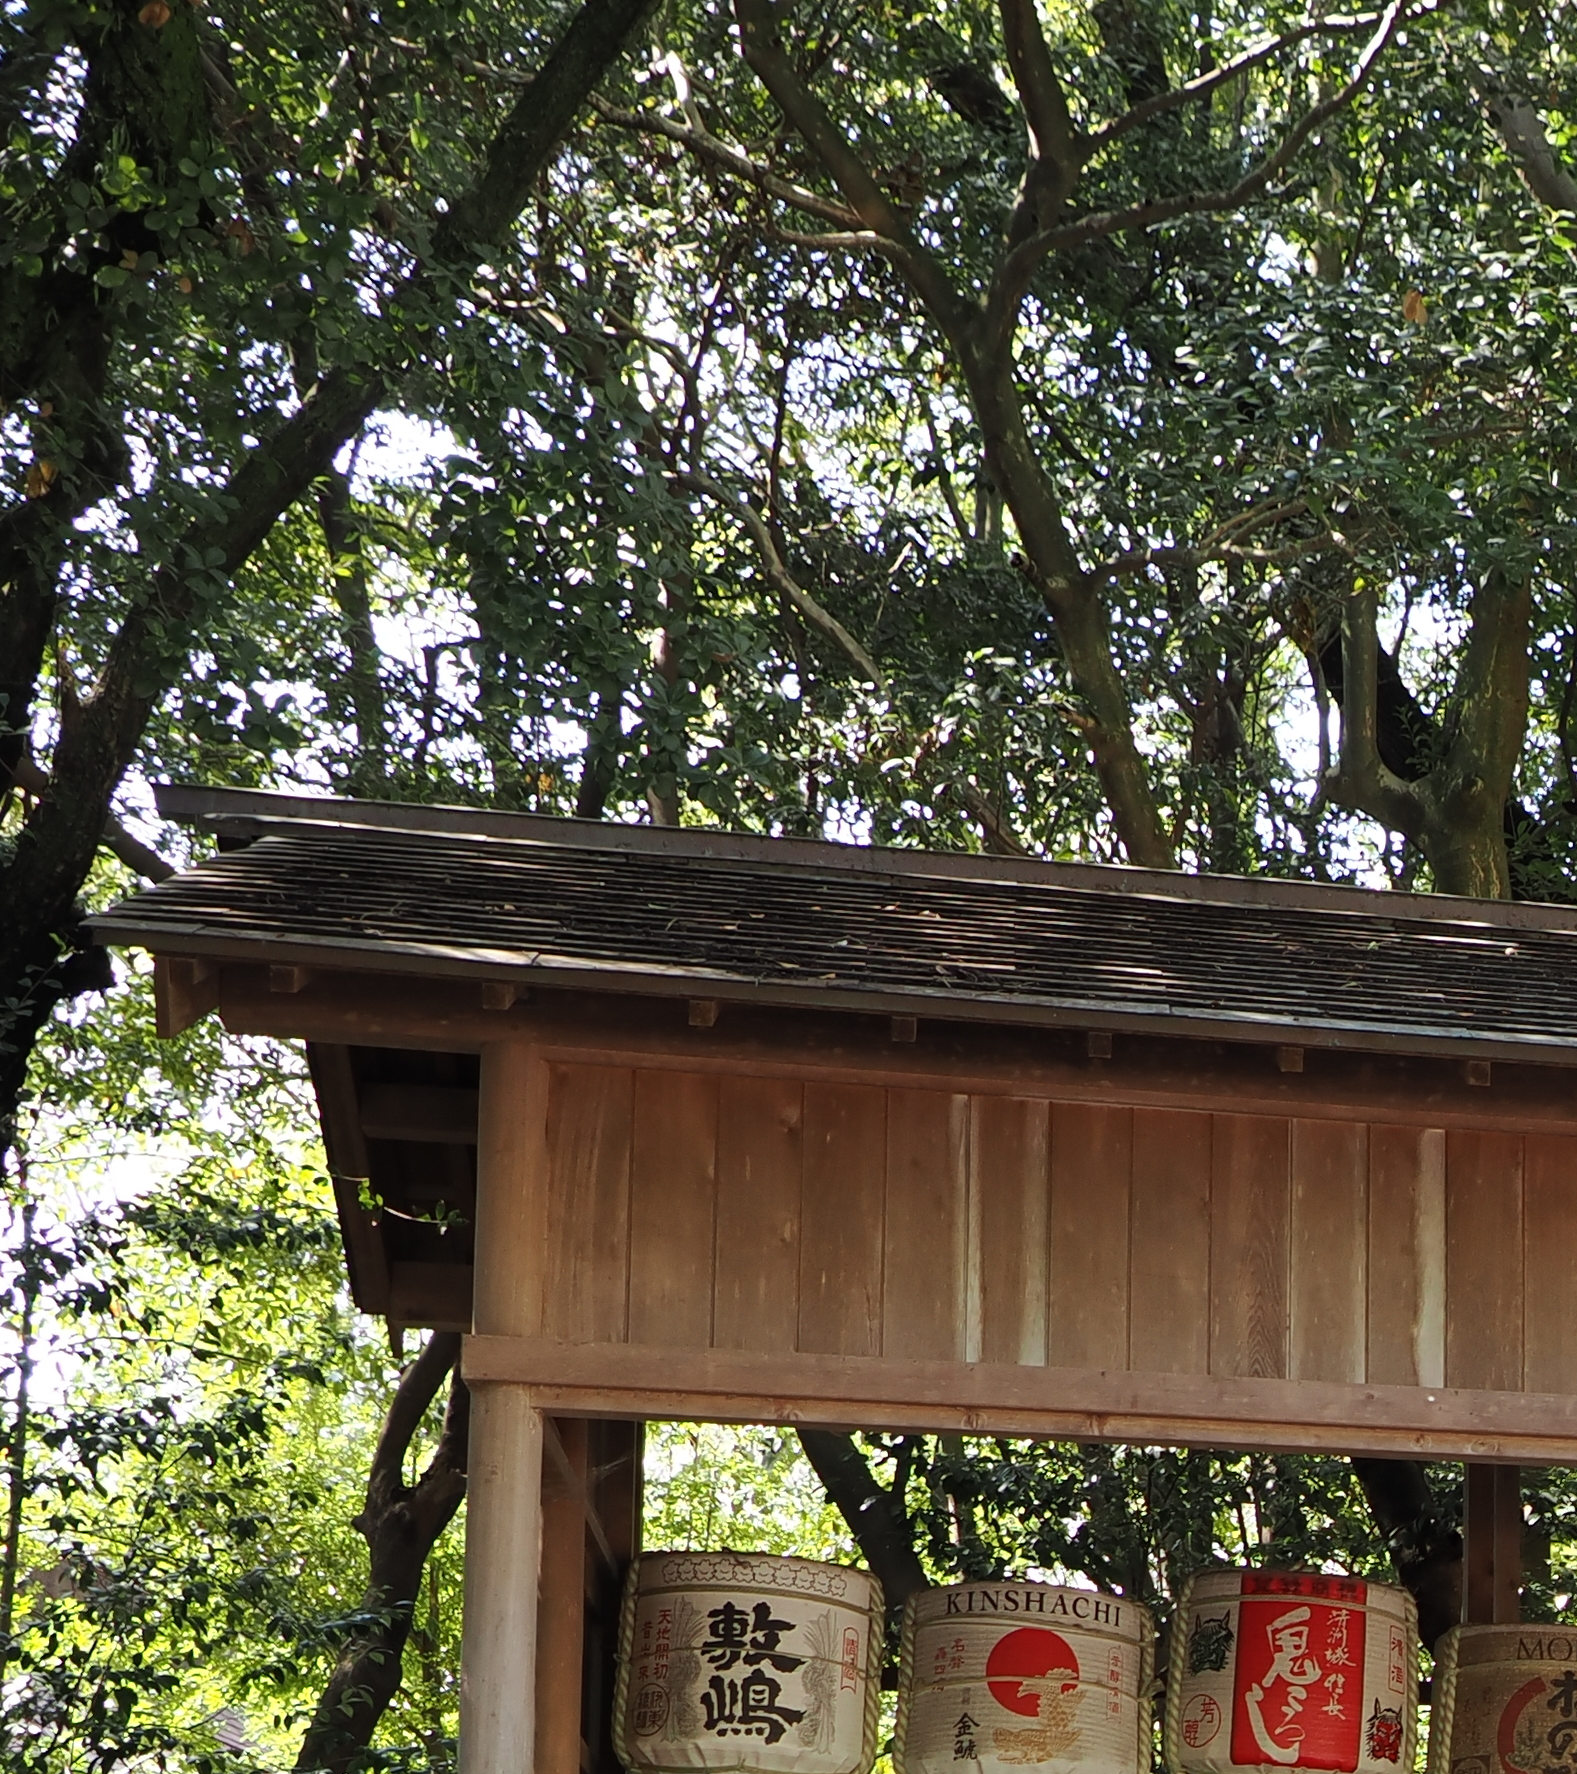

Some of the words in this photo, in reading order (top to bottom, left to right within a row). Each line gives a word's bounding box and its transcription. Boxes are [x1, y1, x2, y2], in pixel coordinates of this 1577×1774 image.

[946, 1590, 1122, 1627] KINSHACHI
[1245, 1607, 1322, 1763] 鬼ころし
[1184, 1699, 1215, 1748] 芳醇
